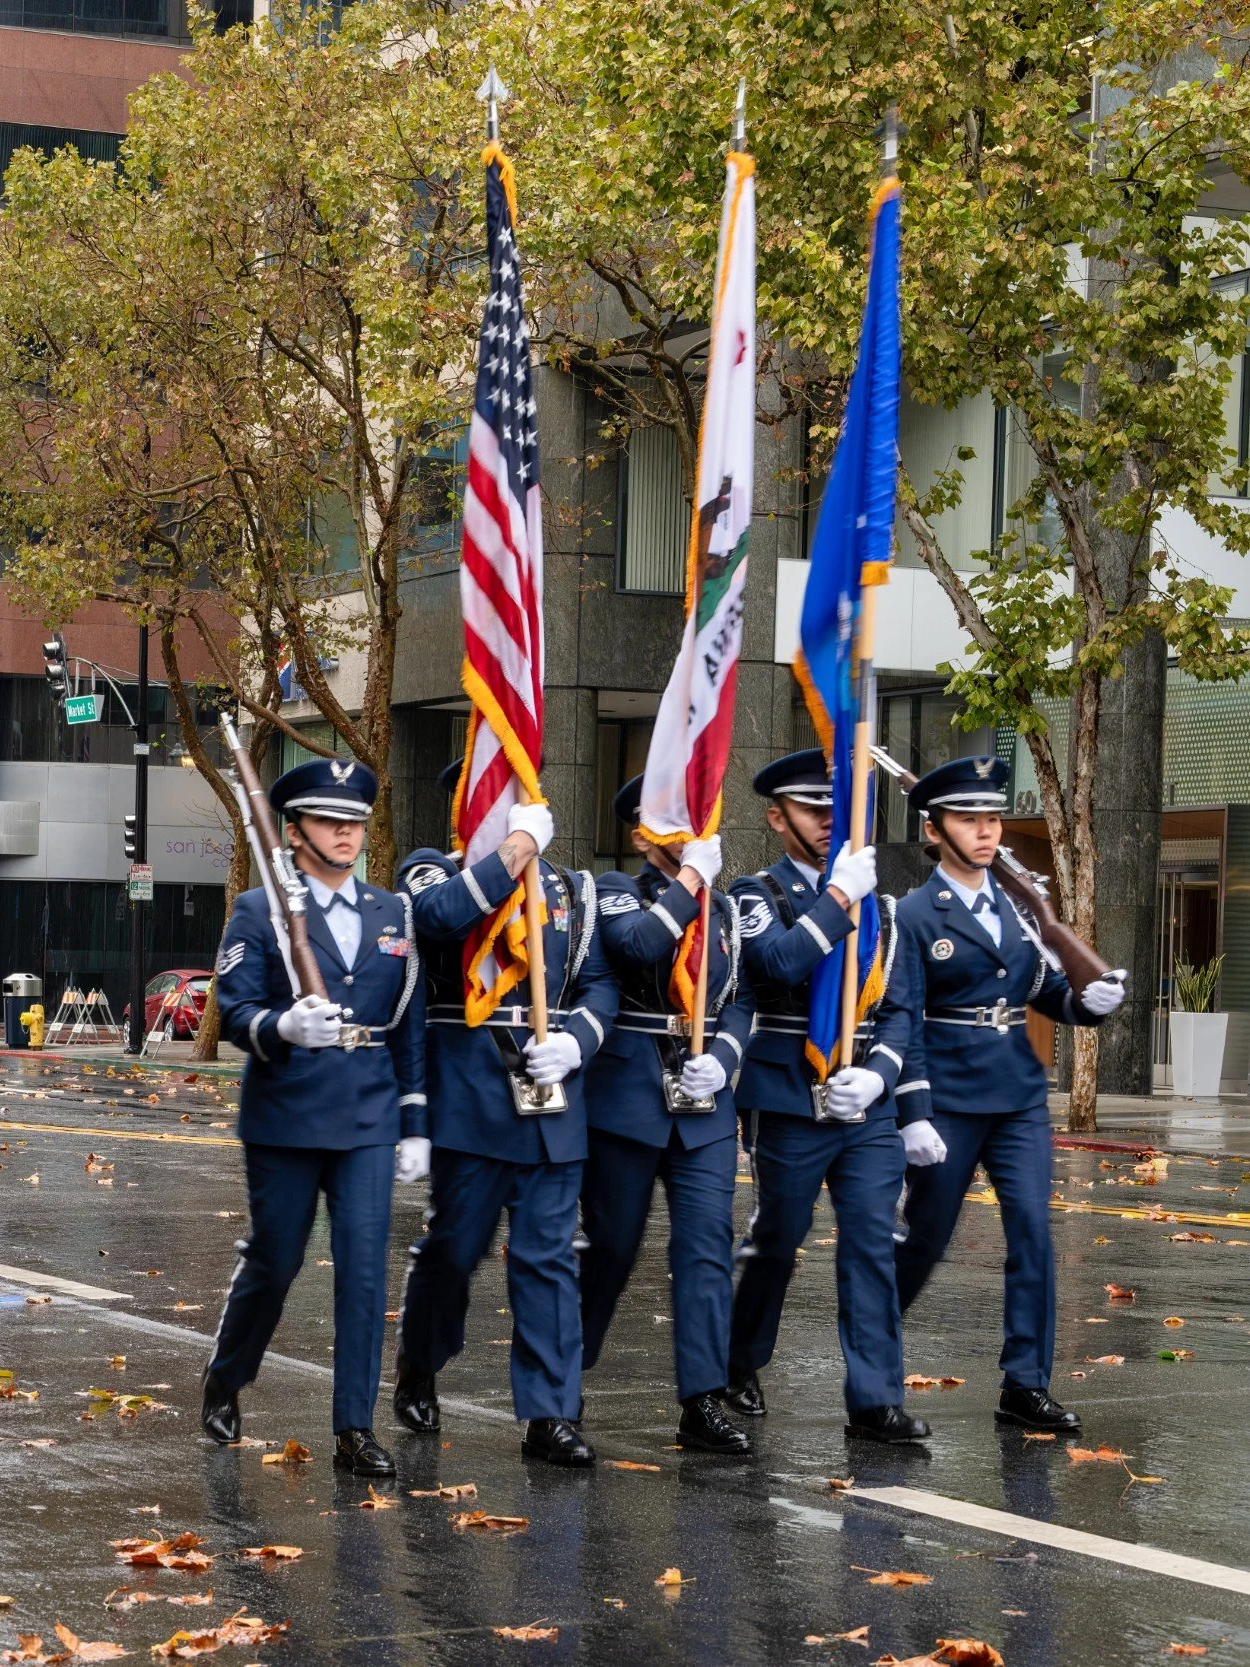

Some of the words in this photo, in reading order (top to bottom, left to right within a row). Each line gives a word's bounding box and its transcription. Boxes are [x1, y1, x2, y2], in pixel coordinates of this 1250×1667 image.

[68, 703, 86, 717] Market
[87, 702, 95, 715] St
[166, 841, 196, 853] san
